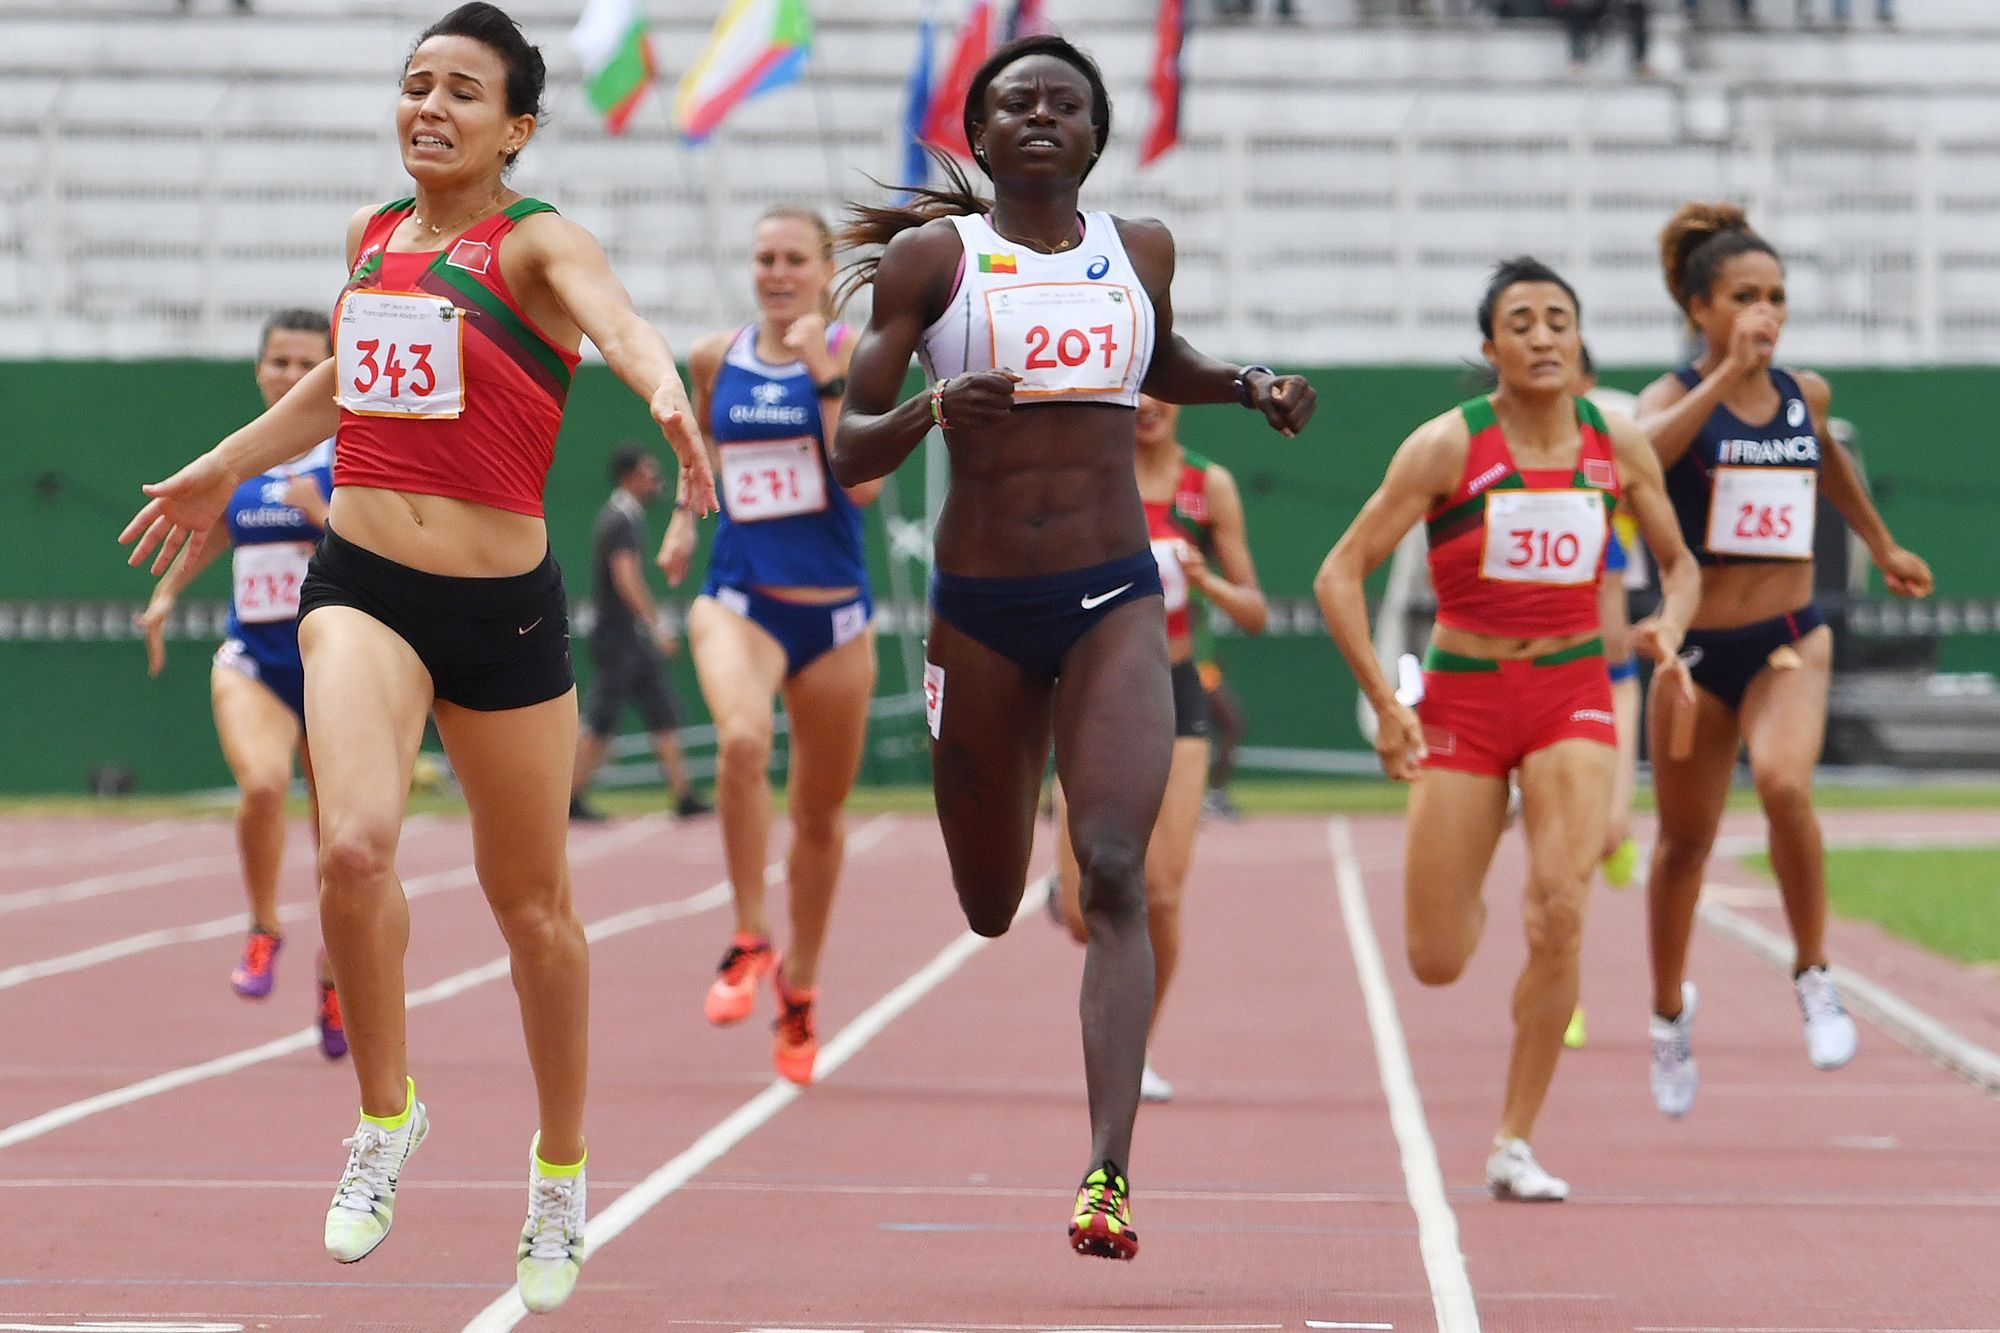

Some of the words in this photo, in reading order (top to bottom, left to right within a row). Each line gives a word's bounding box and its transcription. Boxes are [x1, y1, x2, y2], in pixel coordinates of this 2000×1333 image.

[1025, 324, 1118, 370] 207
[353, 338, 436, 398] 343
[1731, 435, 1820, 464] FRANCE
[737, 466, 799, 504] 271
[1507, 528, 1580, 569] 310
